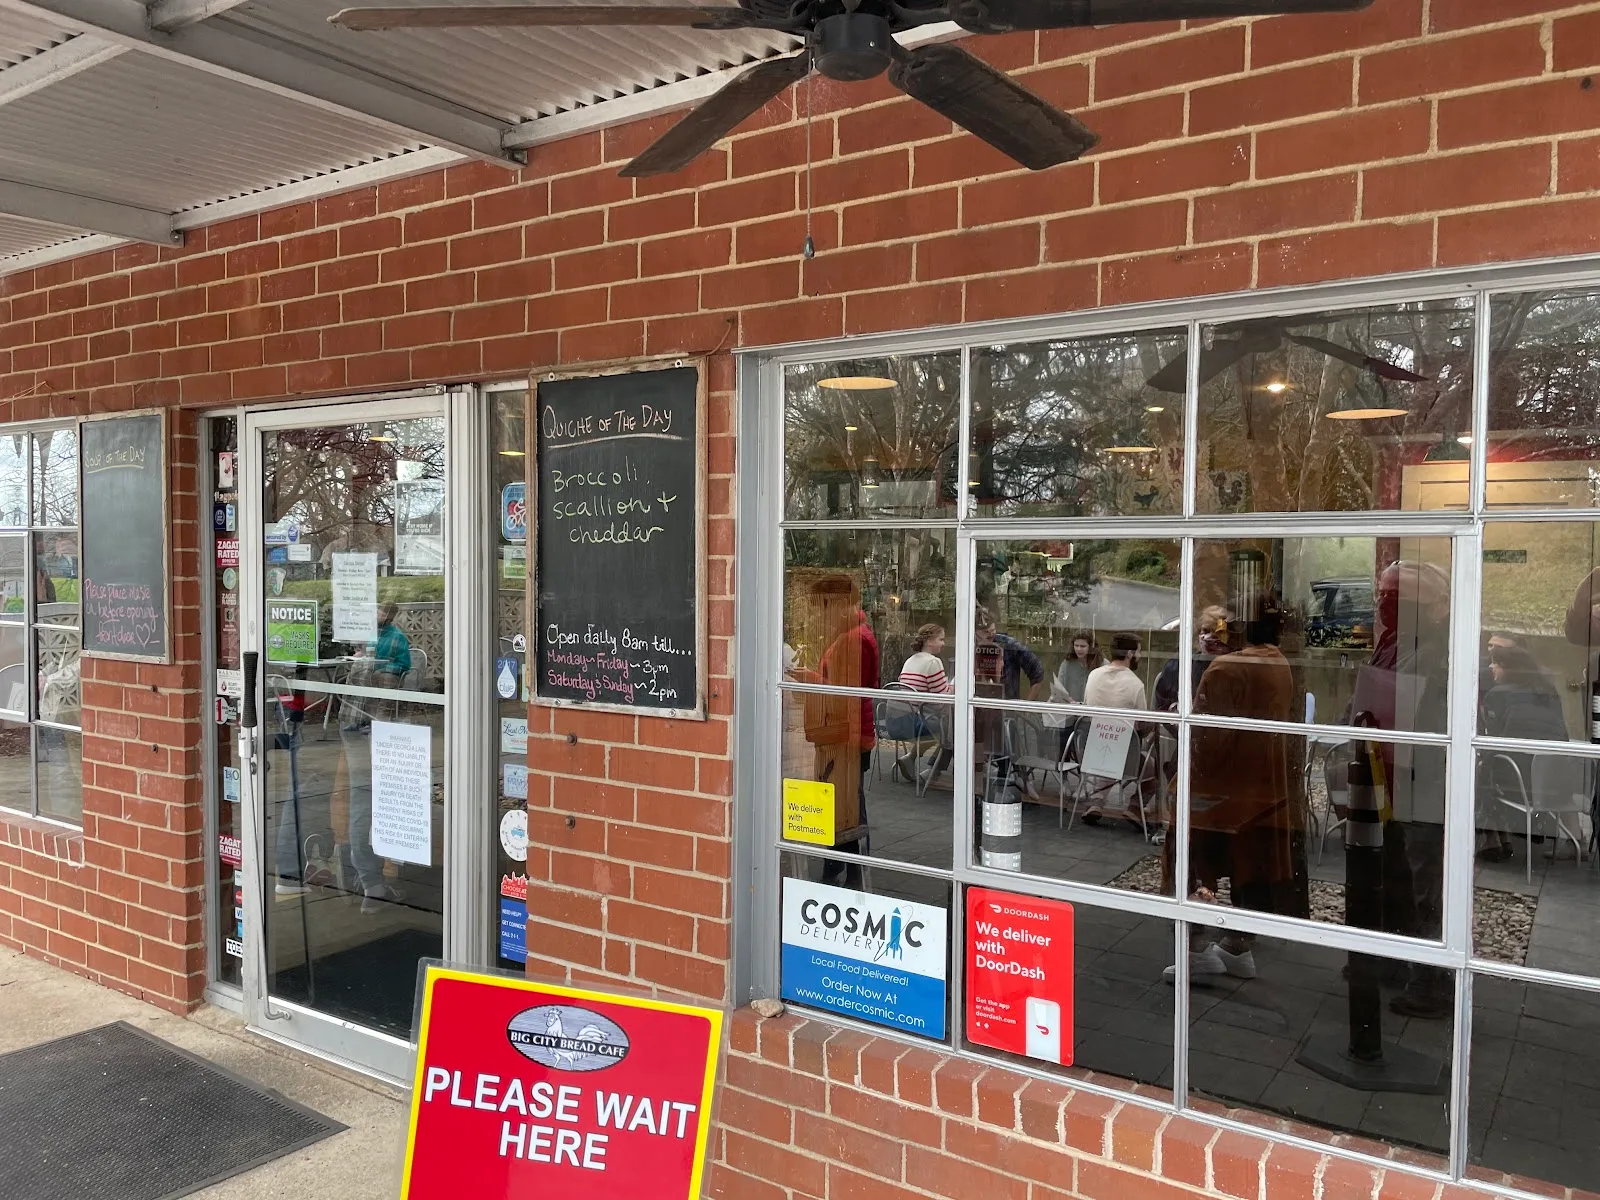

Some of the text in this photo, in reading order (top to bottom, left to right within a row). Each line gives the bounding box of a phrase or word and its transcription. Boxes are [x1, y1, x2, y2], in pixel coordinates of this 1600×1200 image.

[598, 418, 612, 432] OF
[614, 410, 636, 433] THE
[642, 404, 672, 433] DAY
[129, 446, 146, 462] DAY
[553, 495, 651, 520] scallion
[569, 521, 664, 544] cheddar
[217, 541, 239, 549] ZAGAT
[217, 549, 239, 558] RATED
[84, 578, 106, 600] Please
[271, 607, 312, 620] NOTICE
[290, 631, 310, 640] MASKS
[546, 623, 580, 649] Open
[583, 623, 617, 655] daily
[621, 628, 649, 651] 8am
[285, 640, 314, 650] REQUIRED
[975, 647, 1000, 655] OTICE
[1095, 723, 1113, 731] PICK
[1099, 732, 1120, 741] HERE
[788, 802, 823, 814] We deliver
[788, 813, 803, 821] with
[788, 823, 826, 835] Postmates.
[219, 836, 241, 848] ZAGAT
[220, 845, 241, 856] RATED
[1004, 907, 1049, 921] DOORDASH
[509, 922, 526, 930] CONNECTE
[975, 920, 1052, 947] We deliver
[801, 924, 885, 961] DELIVERY
[975, 940, 1006, 956] with
[811, 955, 909, 986] Local Food Delivered!
[975, 954, 1045, 981] DoorDash
[821, 976, 897, 1005] Order Now At
[796, 987, 925, 1028] www.ordercosmic.com
[975, 996, 986, 1005] Get
[987, 998, 998, 1007] the
[982, 1005, 995, 1013] visit
[975, 1010, 1017, 1025] doordash.com
[510, 1031, 625, 1057] BIG CITY BREAD CAFE
[424, 1067, 696, 1139] PLEASE WAIT
[499, 1121, 609, 1171] HERE
